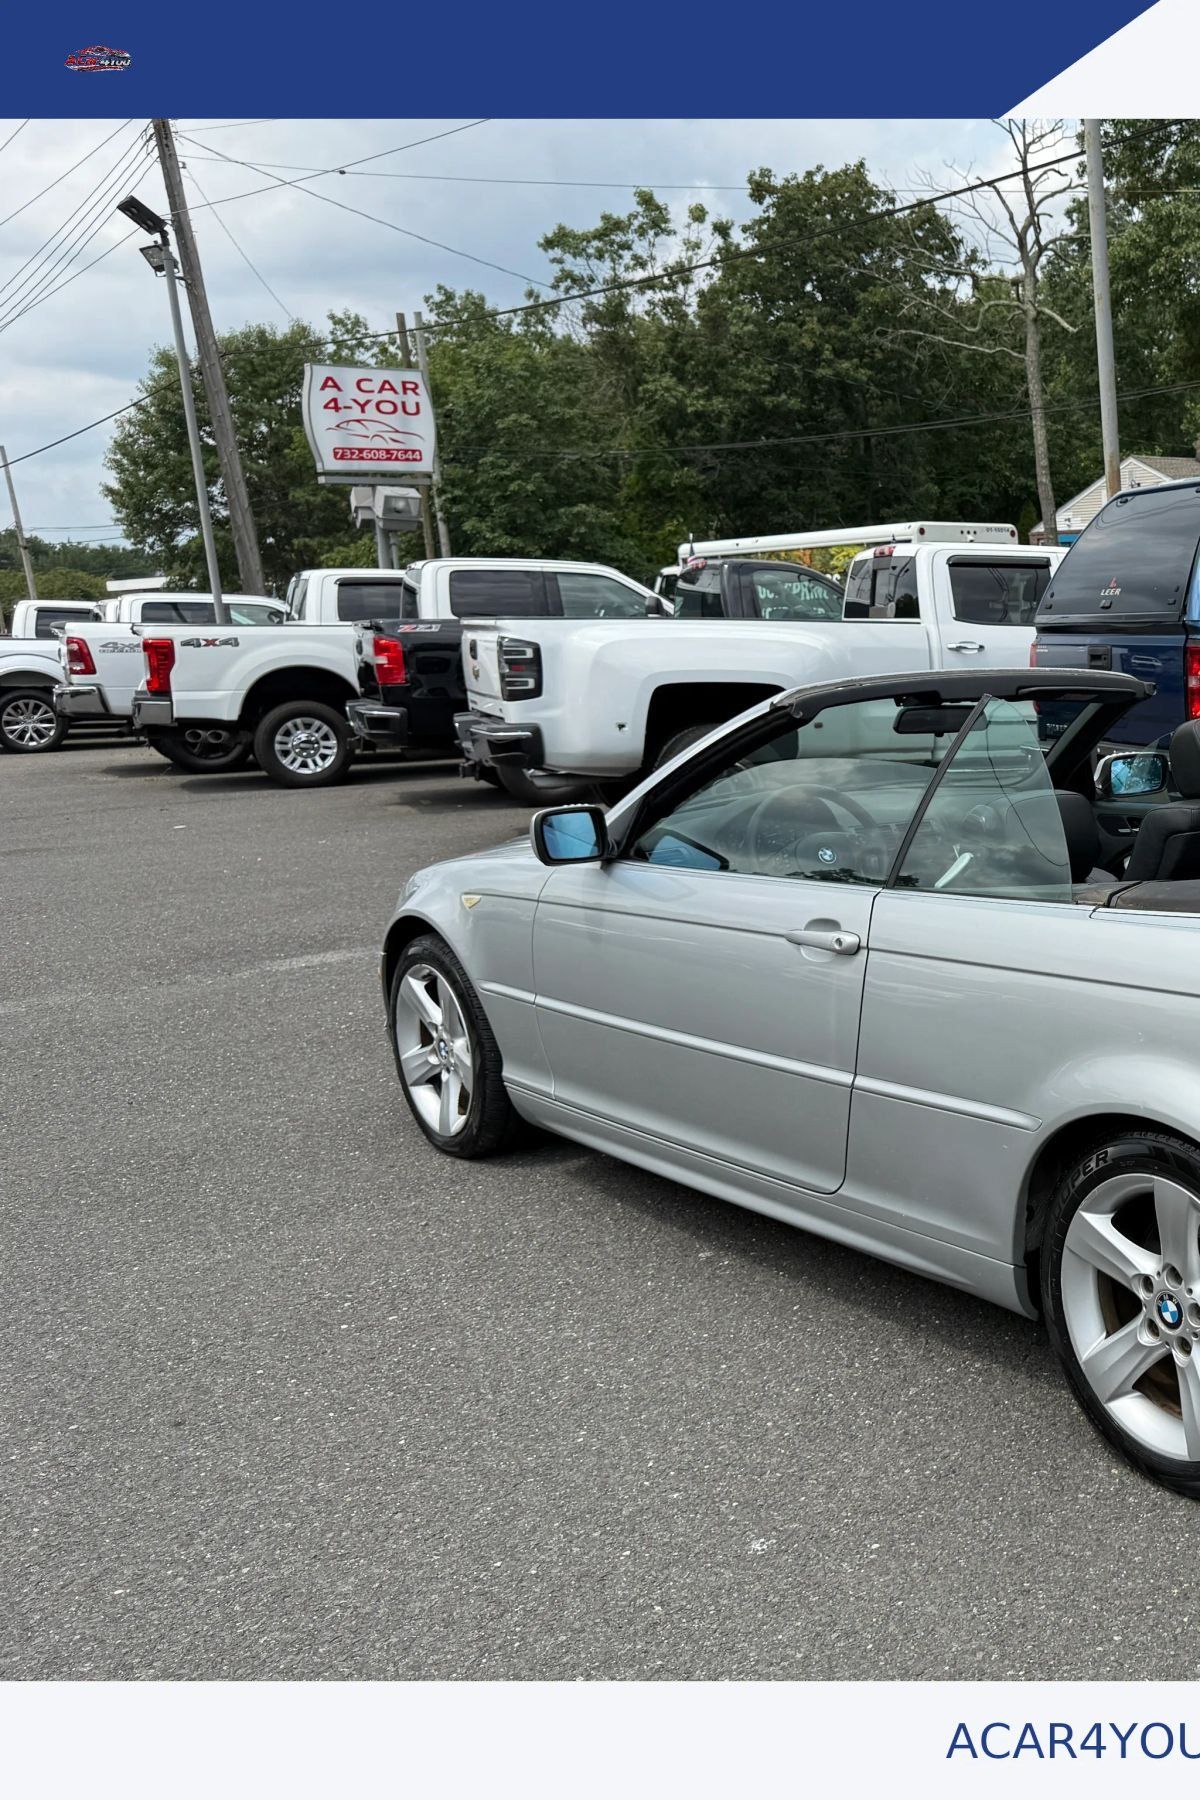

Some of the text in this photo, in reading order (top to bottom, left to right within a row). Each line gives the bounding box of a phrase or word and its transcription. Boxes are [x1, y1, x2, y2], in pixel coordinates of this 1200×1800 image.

[319, 376, 420, 396] A CAR
[323, 397, 420, 416] 4-YOU
[334, 448, 421, 460] 732-608-7644
